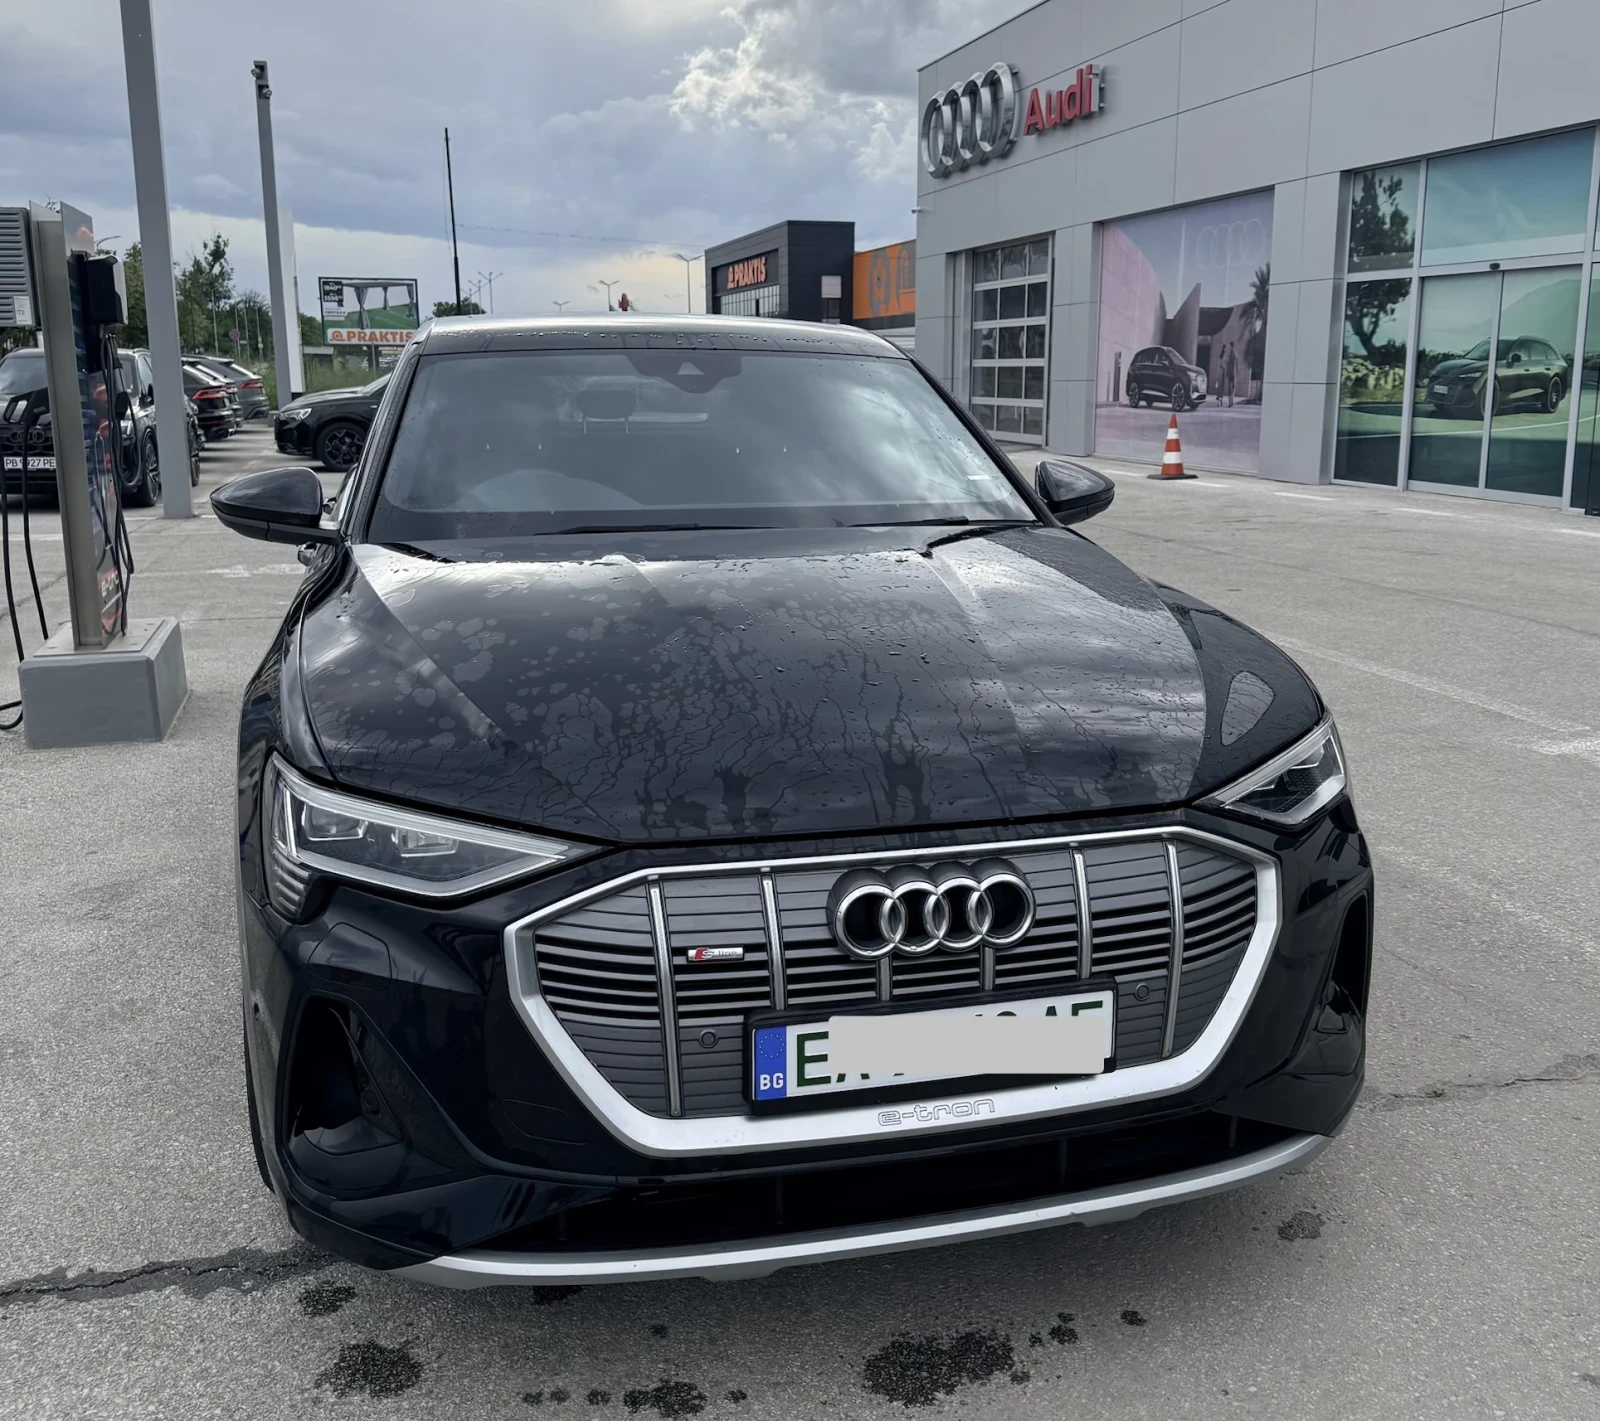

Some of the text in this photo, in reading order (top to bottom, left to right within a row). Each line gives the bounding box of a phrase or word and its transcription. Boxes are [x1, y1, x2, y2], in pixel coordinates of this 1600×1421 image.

[1023, 64, 1096, 136] Audi
[733, 256, 766, 288] PRAKTIS
[346, 330, 413, 343] PRAKTIS
[5, 458, 18, 467] PB
[43, 458, 55, 467] PE
[759, 1072, 784, 1091] BG
[877, 1098, 996, 1127] e-tron
